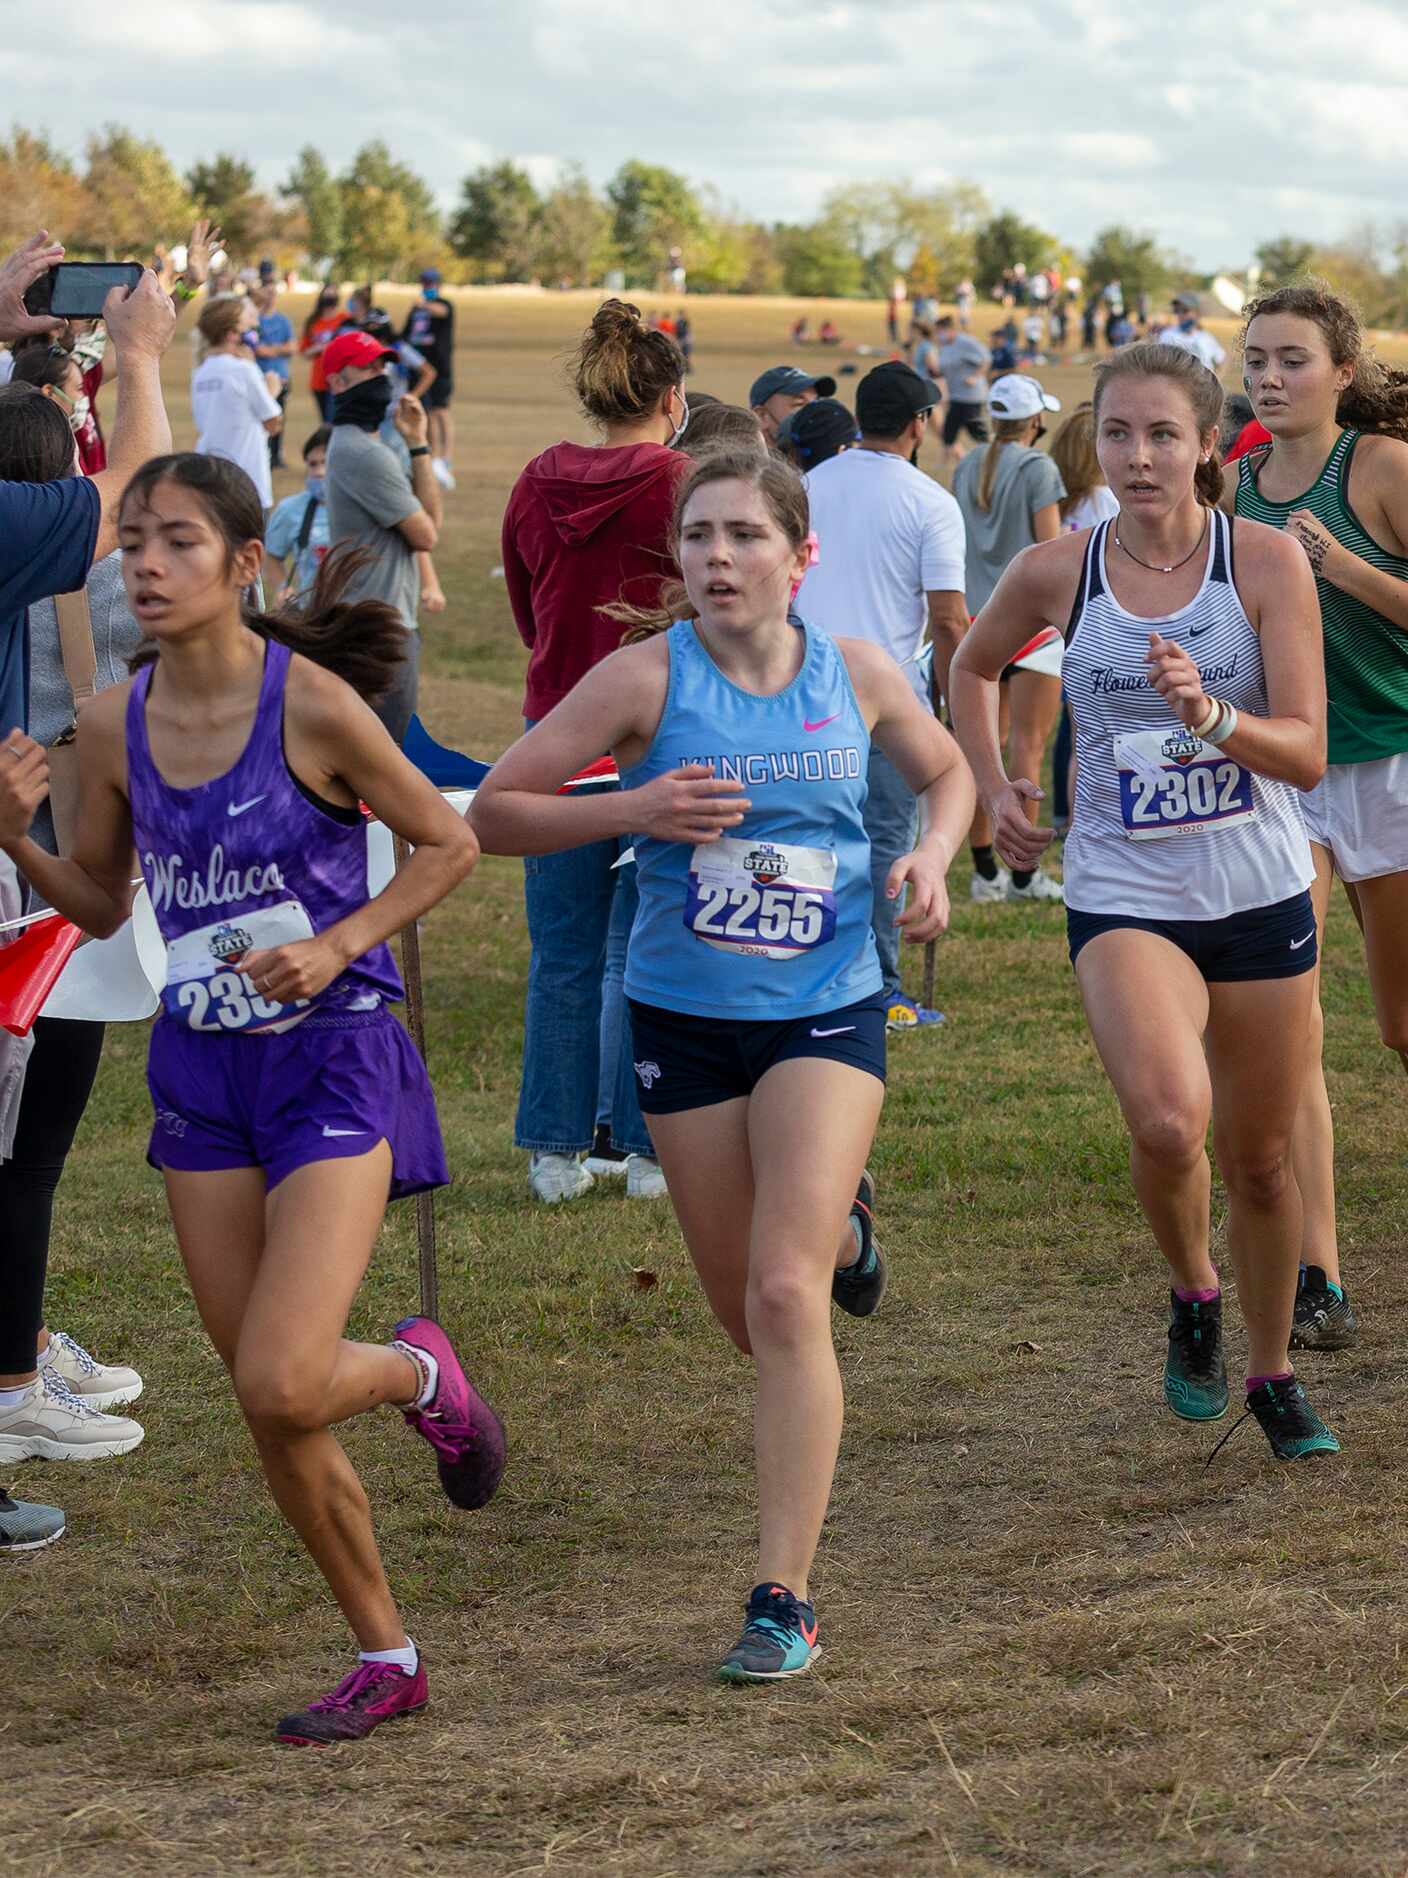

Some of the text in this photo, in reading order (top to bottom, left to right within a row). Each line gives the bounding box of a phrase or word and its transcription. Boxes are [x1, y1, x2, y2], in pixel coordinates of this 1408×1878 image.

[1090, 653, 1239, 695] Flowe und
[1162, 741, 1202, 756] STATE
[1130, 763, 1242, 824] 2302
[1177, 824, 1204, 834] 2020
[145, 843, 284, 912] Weslaco
[743, 856, 789, 873] STATE
[692, 885, 823, 944] 2255
[208, 934, 254, 957] STATE
[739, 946, 769, 957] 2020
[178, 971, 311, 1032] 23
